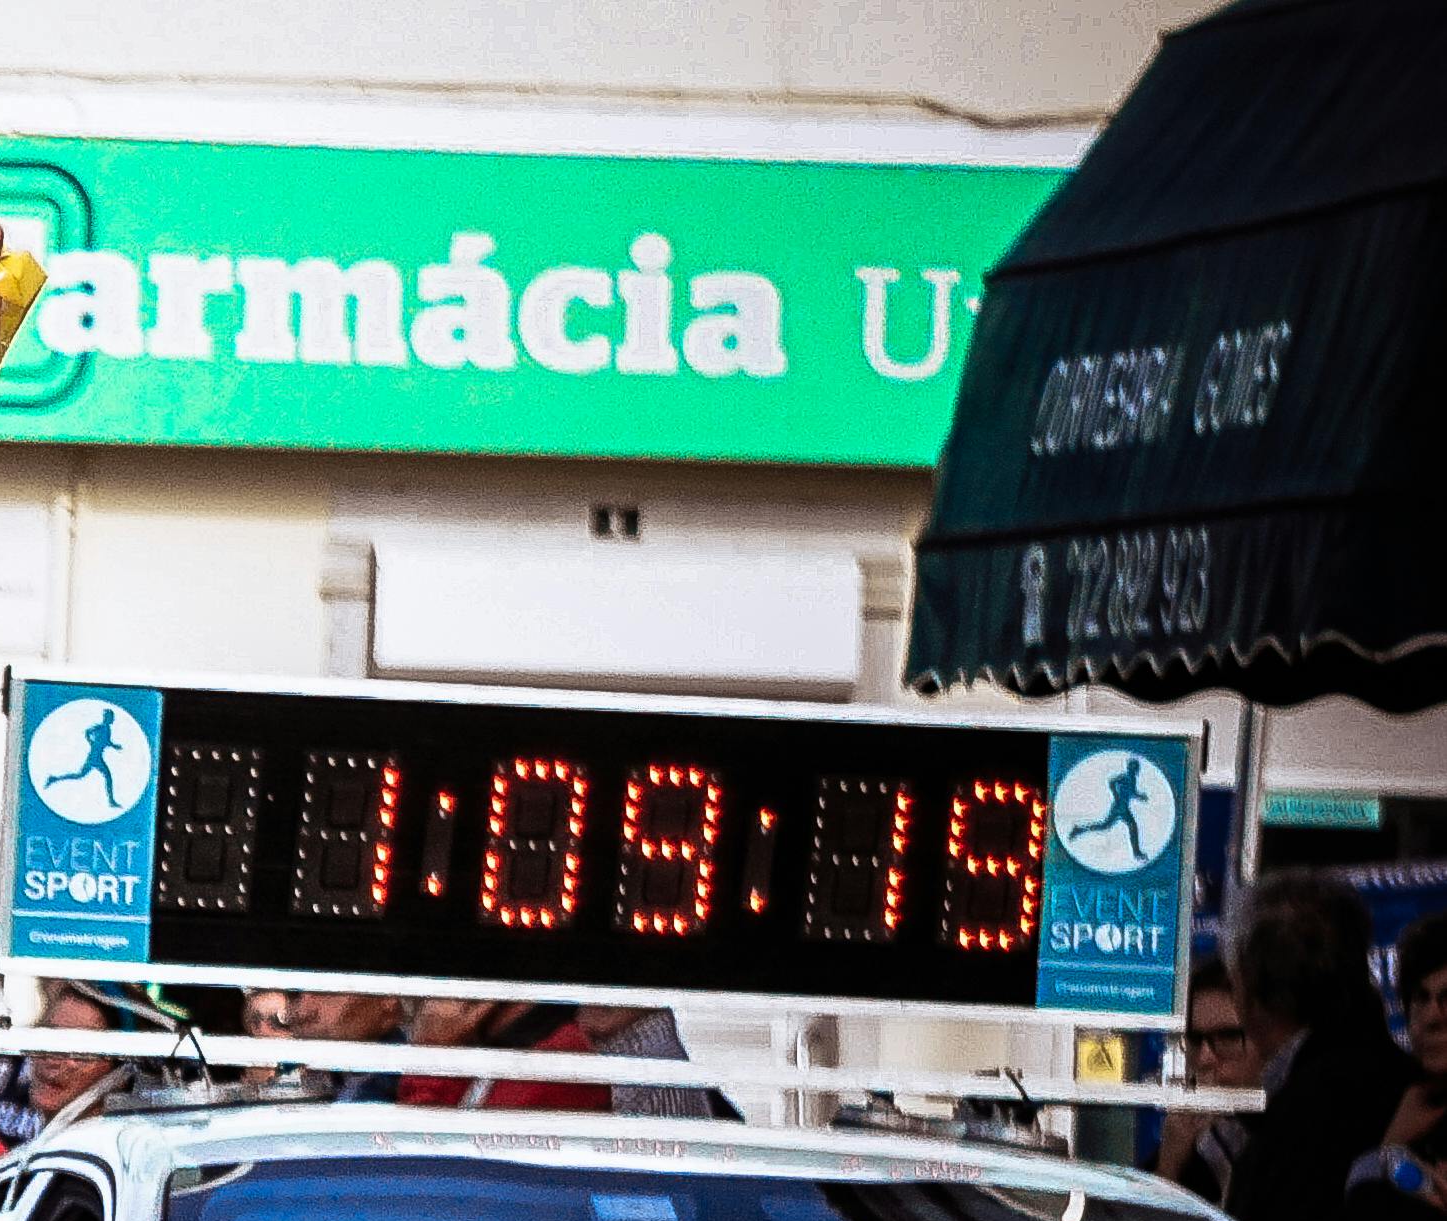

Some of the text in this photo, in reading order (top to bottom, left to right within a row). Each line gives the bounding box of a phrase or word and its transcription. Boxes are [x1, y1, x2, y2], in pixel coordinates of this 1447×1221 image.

[4, 220, 980, 382] armácia U
[25, 836, 140, 872] EVENT
[373, 756, 1047, 952] 1:09:19
[23, 871, 140, 906] SPORT
[1051, 886, 1168, 923] EVENT
[1049, 921, 1165, 957] SPORT
